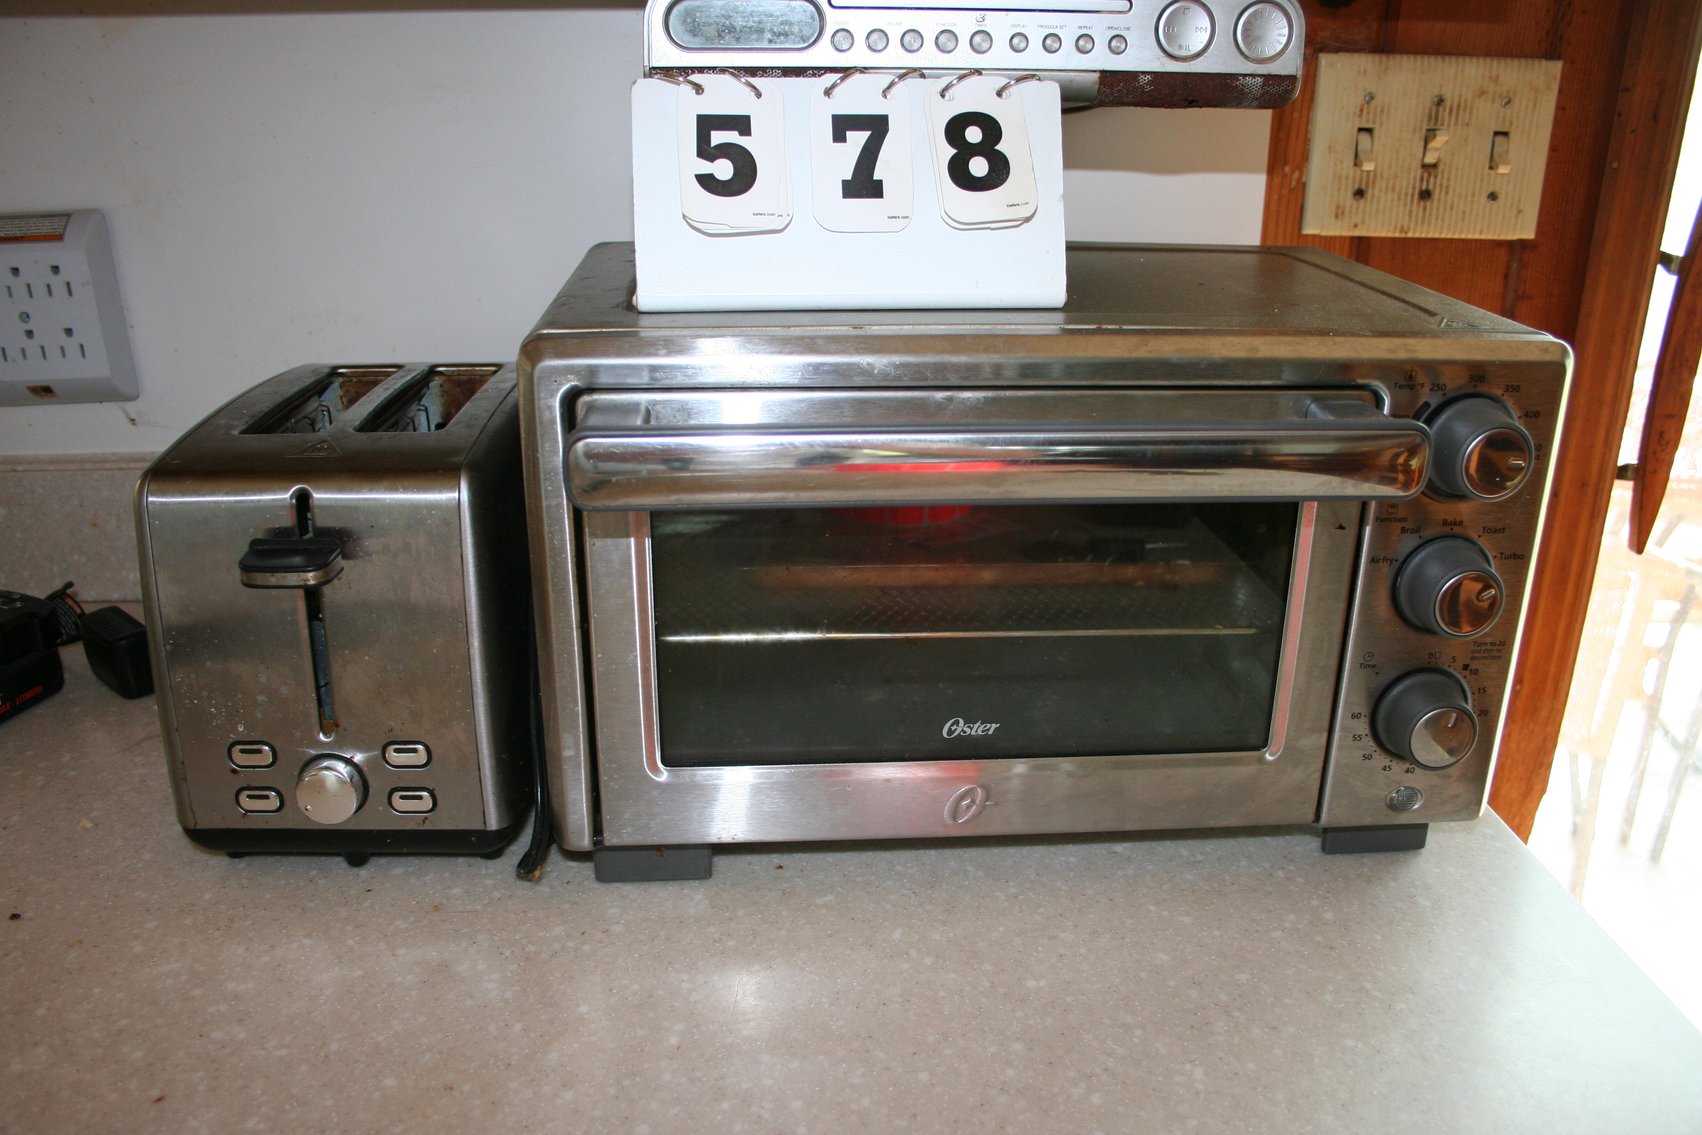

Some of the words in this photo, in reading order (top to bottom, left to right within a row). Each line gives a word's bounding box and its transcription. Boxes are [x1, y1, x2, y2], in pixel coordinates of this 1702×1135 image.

[694, 113, 758, 198] 5
[831, 113, 890, 200] 7
[944, 111, 1011, 192] 8
[1469, 374, 1486, 383] 300
[1430, 383, 1447, 392] 250
[1503, 384, 1520, 393] 350
[1523, 410, 1541, 419] 400
[1375, 515, 1408, 523] Function
[1442, 518, 1464, 527] Bake
[1400, 525, 1422, 534] Broil
[1482, 526, 1506, 534] Toast
[1499, 552, 1525, 561] Turbo
[1451, 656, 1457, 664] 5
[1359, 662, 1377, 670] Time
[1469, 668, 1479, 676] 10
[1478, 687, 1488, 696] 15
[1350, 712, 1362, 720] 60
[1478, 709, 1489, 717] 20
[942, 717, 1000, 739] Oster
[1351, 733, 1363, 742] 55
[1362, 753, 1373, 761] 50
[1381, 764, 1393, 772] 45
[1404, 766, 1416, 774] 40
